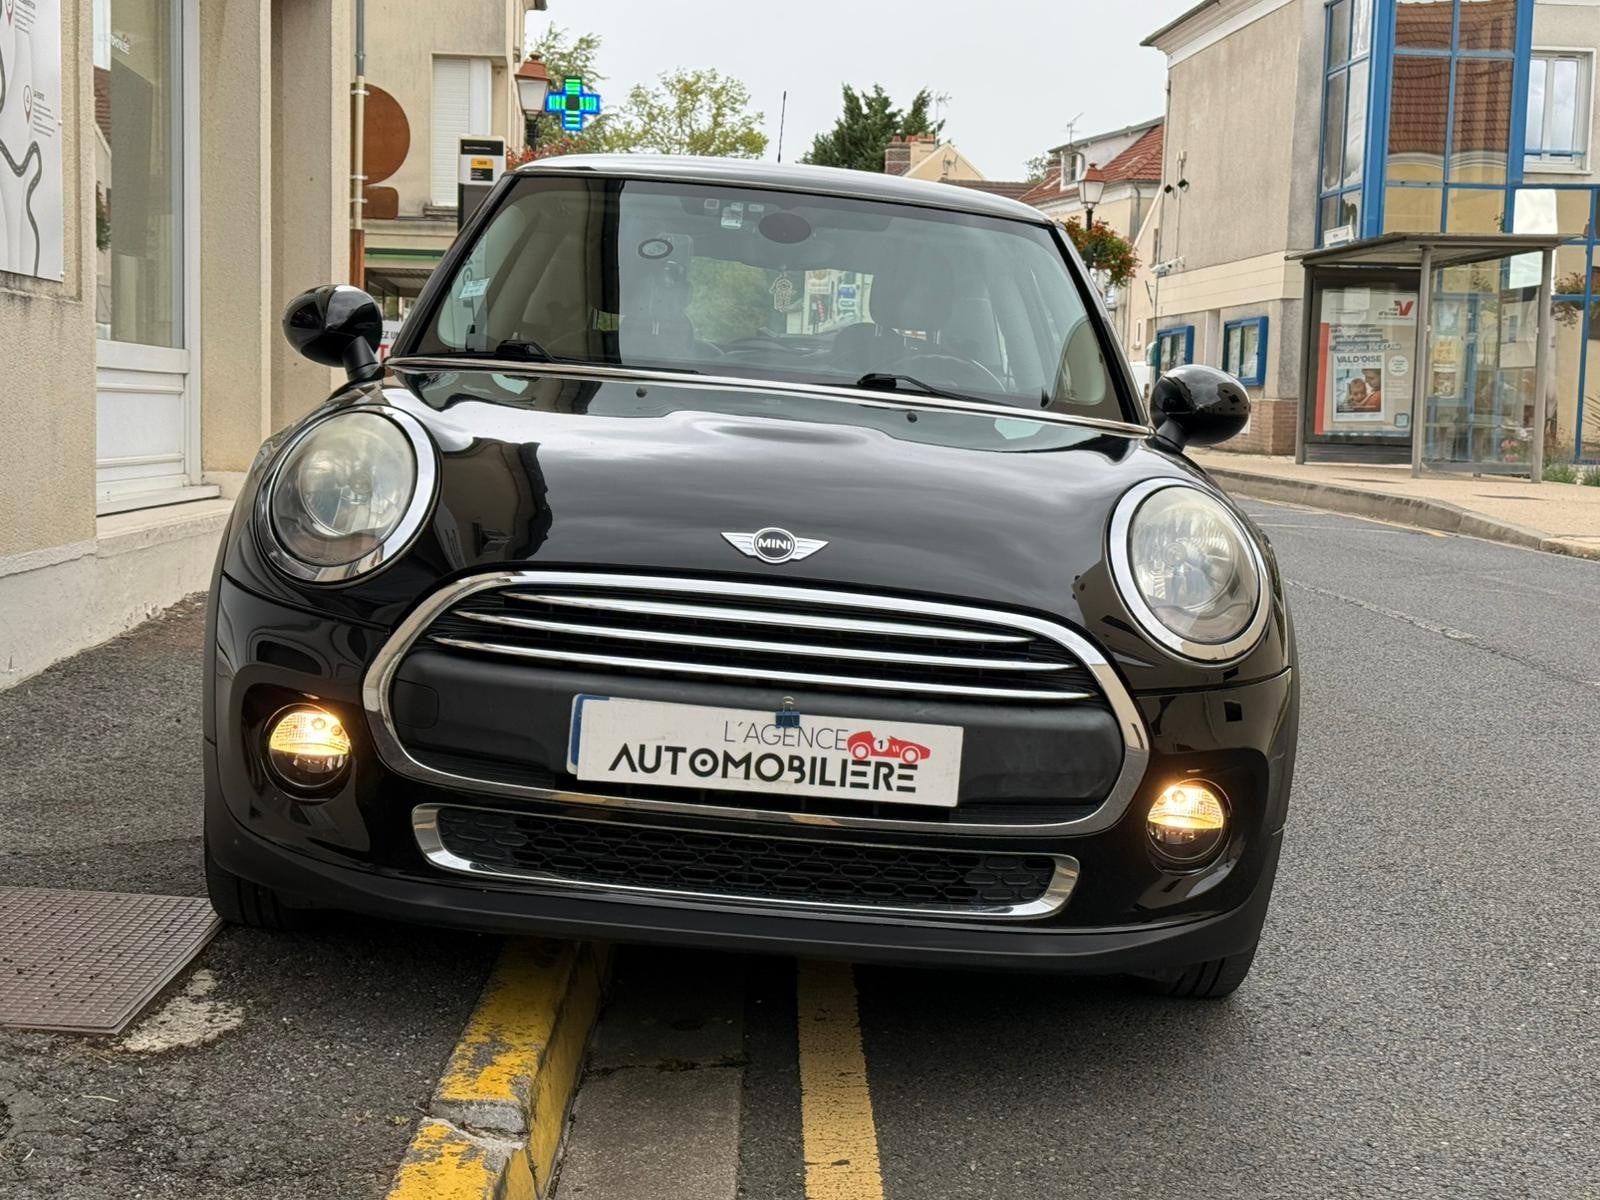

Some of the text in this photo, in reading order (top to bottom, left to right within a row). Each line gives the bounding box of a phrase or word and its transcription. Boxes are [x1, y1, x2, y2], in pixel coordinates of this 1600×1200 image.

[758, 538, 791, 550] MINI
[724, 720, 849, 751] L'AGENCE
[878, 740, 884, 750] 1
